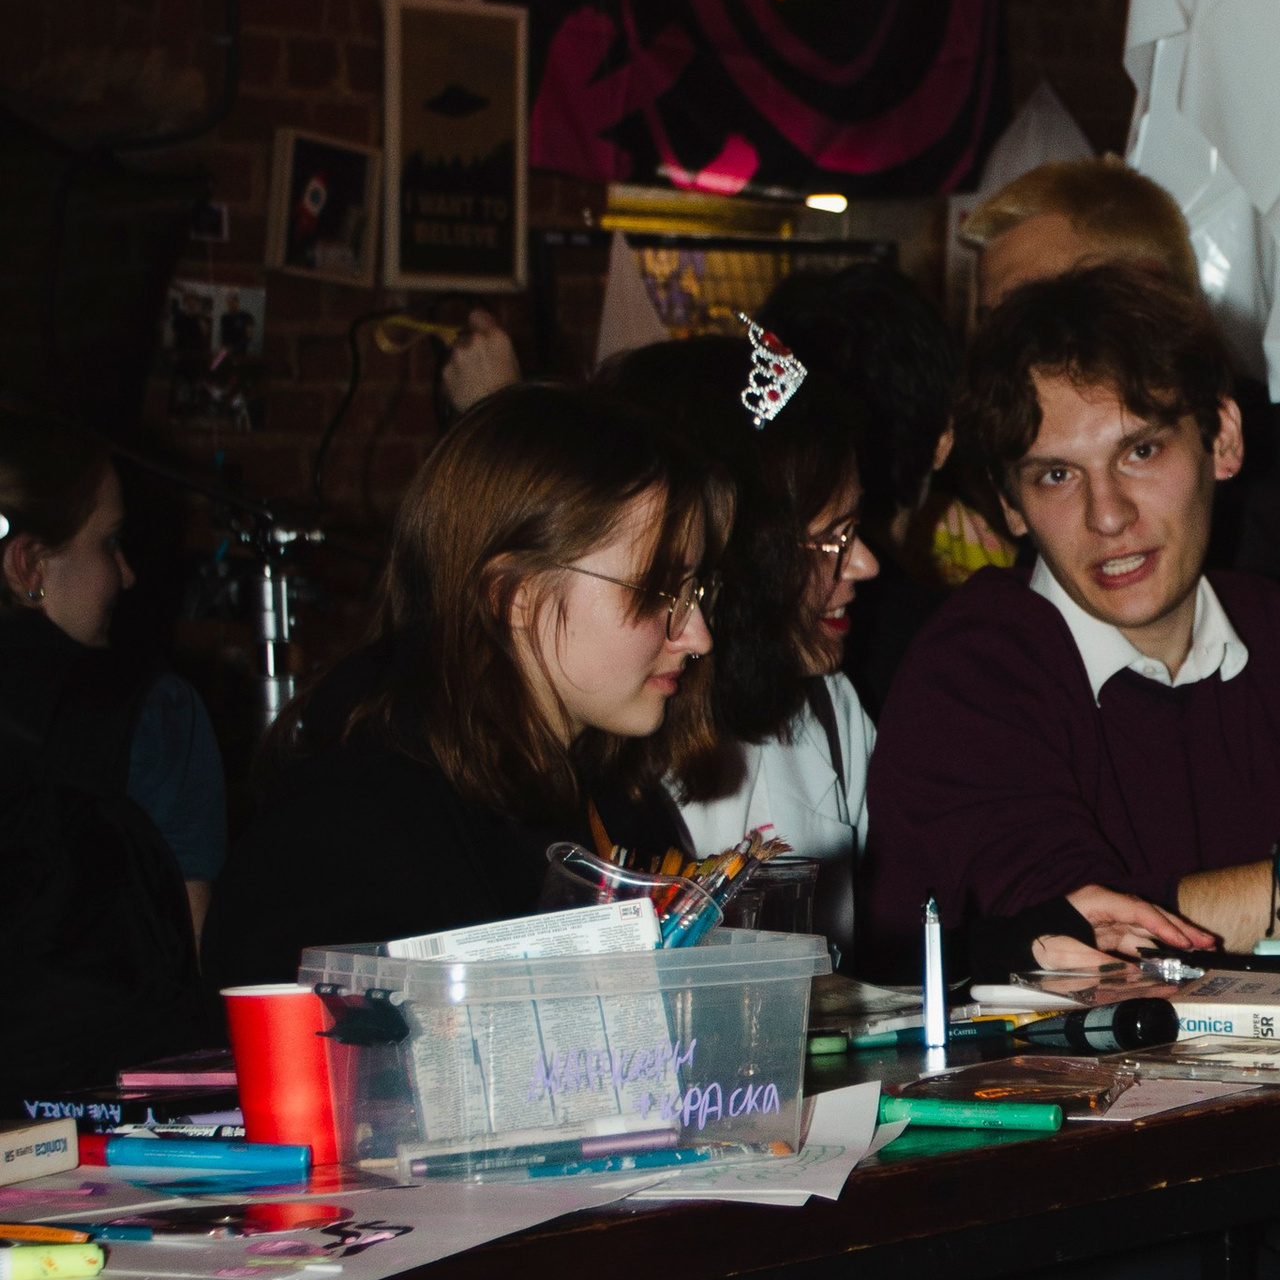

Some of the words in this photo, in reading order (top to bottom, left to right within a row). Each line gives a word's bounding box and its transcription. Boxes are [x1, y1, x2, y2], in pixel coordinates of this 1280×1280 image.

[417, 192, 475, 218] WANT
[480, 195, 508, 221] TO
[413, 219, 498, 249] BELIEVE
[34, 1137, 69, 1158] Konica
